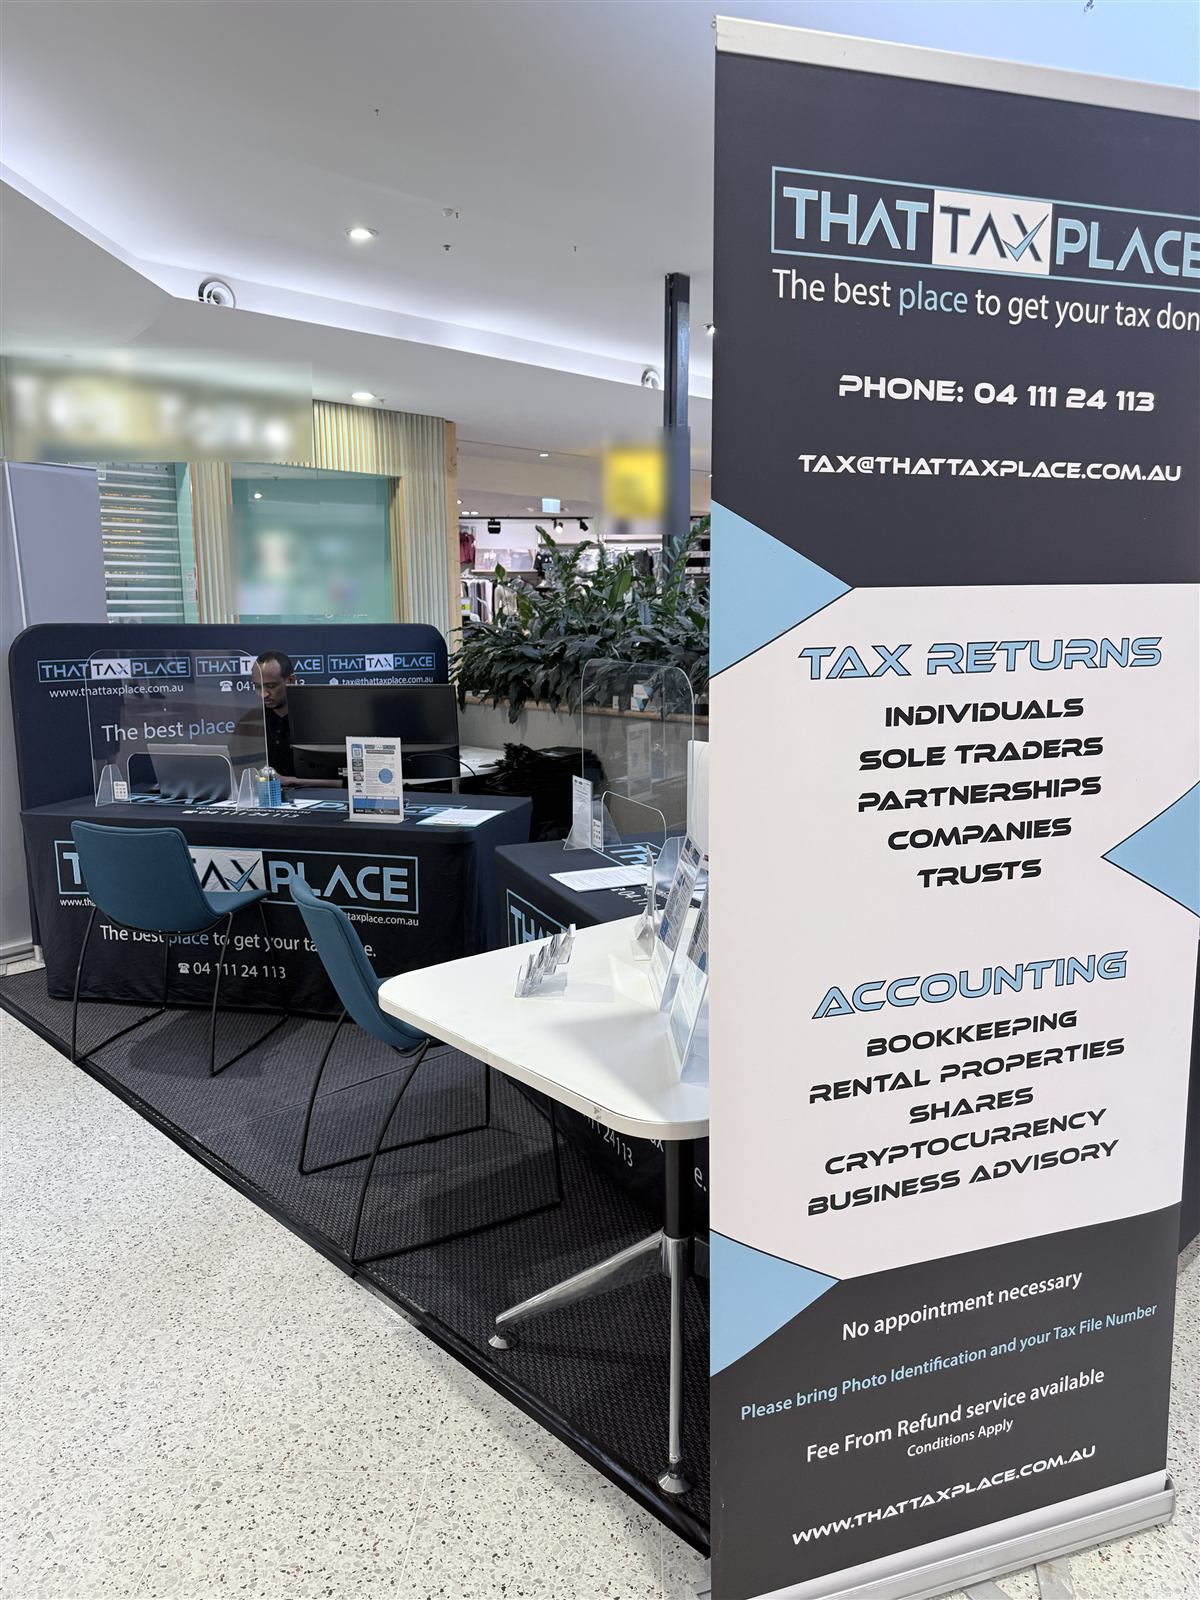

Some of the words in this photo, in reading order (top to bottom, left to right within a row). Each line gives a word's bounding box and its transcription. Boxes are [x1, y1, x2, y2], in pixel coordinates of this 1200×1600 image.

[772, 267, 825, 301] The
[833, 273, 891, 308] best
[898, 280, 968, 316] place
[975, 289, 1001, 316] to
[1008, 294, 1049, 326] get
[1055, 299, 1110, 329] your
[1115, 301, 1151, 328] tax
[838, 374, 964, 404] PHONE:
[973, 382, 1018, 405] 04
[1026, 385, 1058, 408] 111
[1065, 388, 1108, 411] 24
[1116, 390, 1155, 413] 113
[798, 454, 1182, 482] TAX@THATTAXPLACE.COM.AU
[798, 643, 912, 681] TAX
[926, 636, 1164, 676] RETURNS
[49, 684, 184, 699] www.thattaxplace.com.au
[101, 724, 139, 742] The
[143, 721, 184, 739] best
[188, 718, 236, 740] place
[884, 697, 1085, 728] INDIVIDUALS
[858, 745, 947, 772] SOLE
[954, 736, 1104, 766] TRADERS
[857, 775, 1103, 814] PARTNERSHIPS
[887, 817, 1073, 851] COMPANIES
[916, 858, 1043, 889] TRUSTS
[99, 925, 129, 941] The
[212, 932, 230, 946] to
[233, 934, 261, 951] get
[263, 936, 300, 952] your
[192, 962, 211, 975] 04
[215, 963, 237, 977] 111
[241, 964, 259, 978] 24
[262, 965, 287, 979] 113
[811, 950, 1129, 1020] ACCOUNTING
[866, 1009, 1078, 1058] BOOKKEEPING
[809, 1068, 932, 1105] RENTAL
[938, 1037, 1126, 1084] PROPERTIES
[908, 1086, 1035, 1126] SHARES
[823, 1108, 1108, 1177] CRYPTOCURRENCY
[807, 1169, 961, 1218] BUSINESS
[968, 1138, 1120, 1186] ADVISORY
[842, 1320, 869, 1342] No
[873, 1290, 994, 1338] appointment
[998, 1271, 1083, 1305] necessary
[740, 1395, 793, 1422] Please
[796, 1384, 838, 1412] bring
[841, 1372, 888, 1396] Photo
[890, 1347, 987, 1383] Identification
[990, 1337, 1017, 1359] and
[1019, 1330, 1051, 1357] your
[1053, 1323, 1077, 1342] Tax
[1079, 1317, 1103, 1336] File
[1105, 1303, 1158, 1329] Number
[806, 1440, 840, 1464] Fee
[844, 1425, 893, 1455] From
[897, 1404, 963, 1438] Refund
[965, 1392, 1026, 1420] service
[1029, 1368, 1106, 1403] available
[906, 1430, 975, 1459] Conditions
[977, 1417, 1014, 1445] Apply
[791, 1444, 1097, 1546] WWW.THATTAXPLACE.COM.AU
